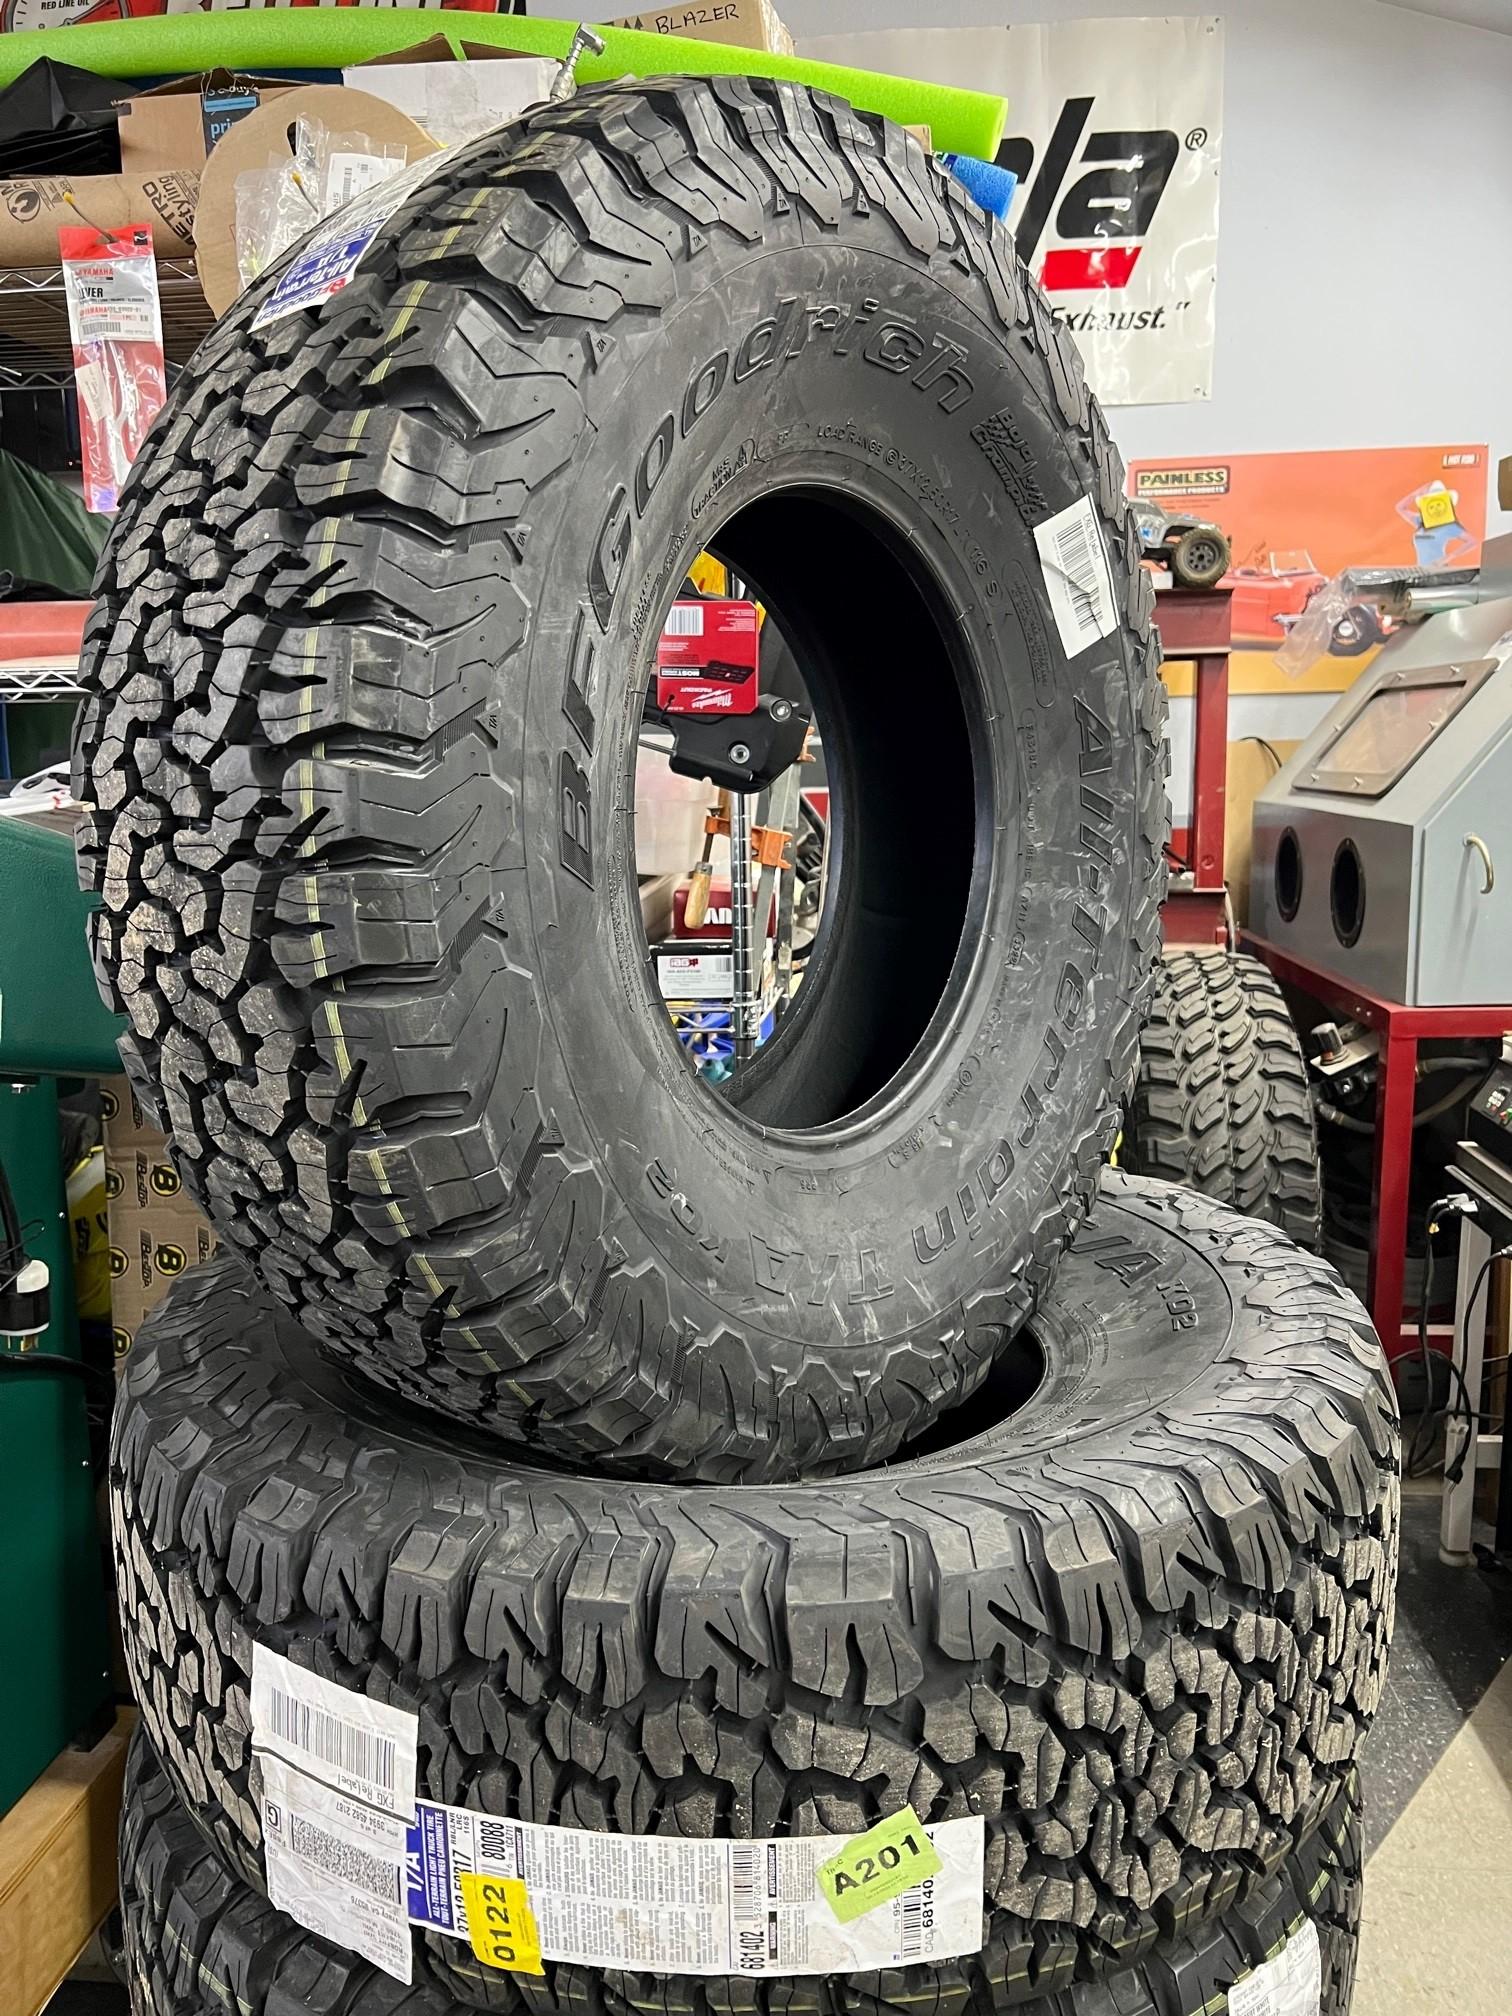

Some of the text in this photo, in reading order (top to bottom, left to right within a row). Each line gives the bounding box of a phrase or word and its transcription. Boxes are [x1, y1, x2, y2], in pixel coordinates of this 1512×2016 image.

[41, 1, 58, 11] RED
[59, 0, 76, 9] LINE
[656, 4, 740, 35] BLAZER
[210, 118, 235, 138] pri
[82, 267, 114, 276] YAMAHA
[272, 254, 357, 300] All-Terrain
[257, 277, 346, 322] BFGoodrich
[817, 424, 846, 439] LOAD
[847, 431, 884, 456] RANGE
[1140, 471, 1225, 487] PAINLESS
[558, 294, 975, 888] BFGoodrich
[691, 693, 734, 709] Milwaukee
[748, 1231, 895, 1306] T/A
[1069, 1235, 1166, 1288] /A
[1155, 1278, 1197, 1333] KO2
[338, 1774, 394, 1809] FXG Relabel
[267, 1806, 279, 1828] G
[481, 1820, 505, 1861] 80088
[427, 1815, 440, 1918] ALL-TERRAIN LIGHT TRUCK TIRE
[436, 1812, 449, 1924] TOUT-TERRAIN PNEU CAMIONNETTE
[753, 1848, 761, 1880] 814020
[834, 1834, 921, 1897] A201
[753, 1885, 762, 1917] 528706
[922, 1875, 933, 1927] 68140
[483, 1885, 515, 1961] 0122
[740, 1932, 764, 1969] 681402
